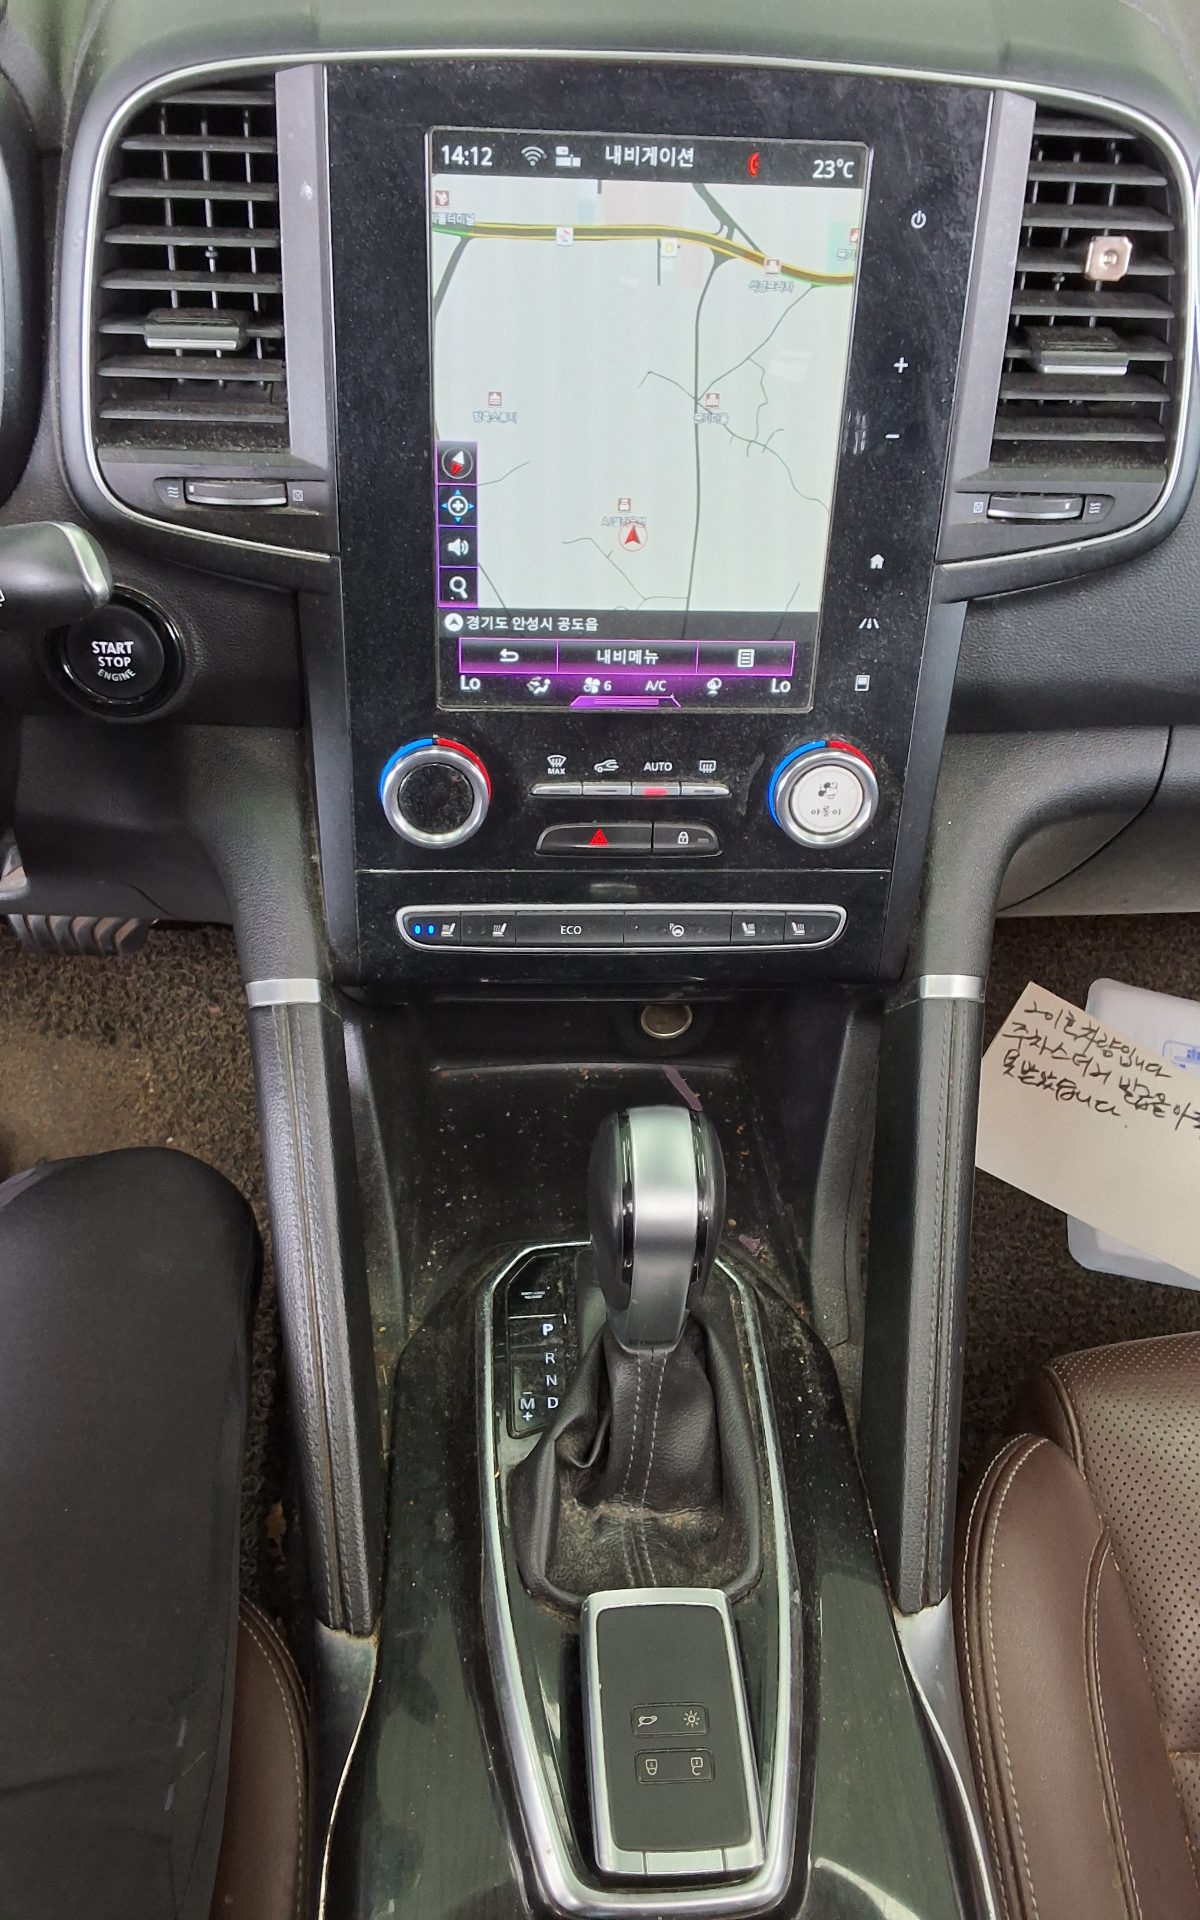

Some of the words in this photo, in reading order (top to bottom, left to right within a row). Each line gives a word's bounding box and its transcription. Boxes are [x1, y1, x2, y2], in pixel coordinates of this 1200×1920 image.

[441, 144, 493, 166] 14:12
[605, 144, 695, 168] 내비게이션
[466, 615, 509, 631] 경기도
[512, 616, 553, 632] 안성시
[557, 617, 599, 632] 공도읍
[91, 640, 135, 655] START
[97, 656, 131, 668] STOP
[597, 648, 660, 665] 내비메뉴
[97, 668, 137, 682] ENGINE
[603, 680, 612, 692] 6
[644, 680, 667, 692] A/C
[547, 766, 566, 775] MAX
[643, 761, 673, 773] AUTO
[560, 925, 582, 936] ECO
[542, 1323, 554, 1336] P
[545, 1352, 556, 1364] R
[546, 1374, 558, 1387] N
[520, 1397, 536, 1410] M
[547, 1396, 559, 1409] D
